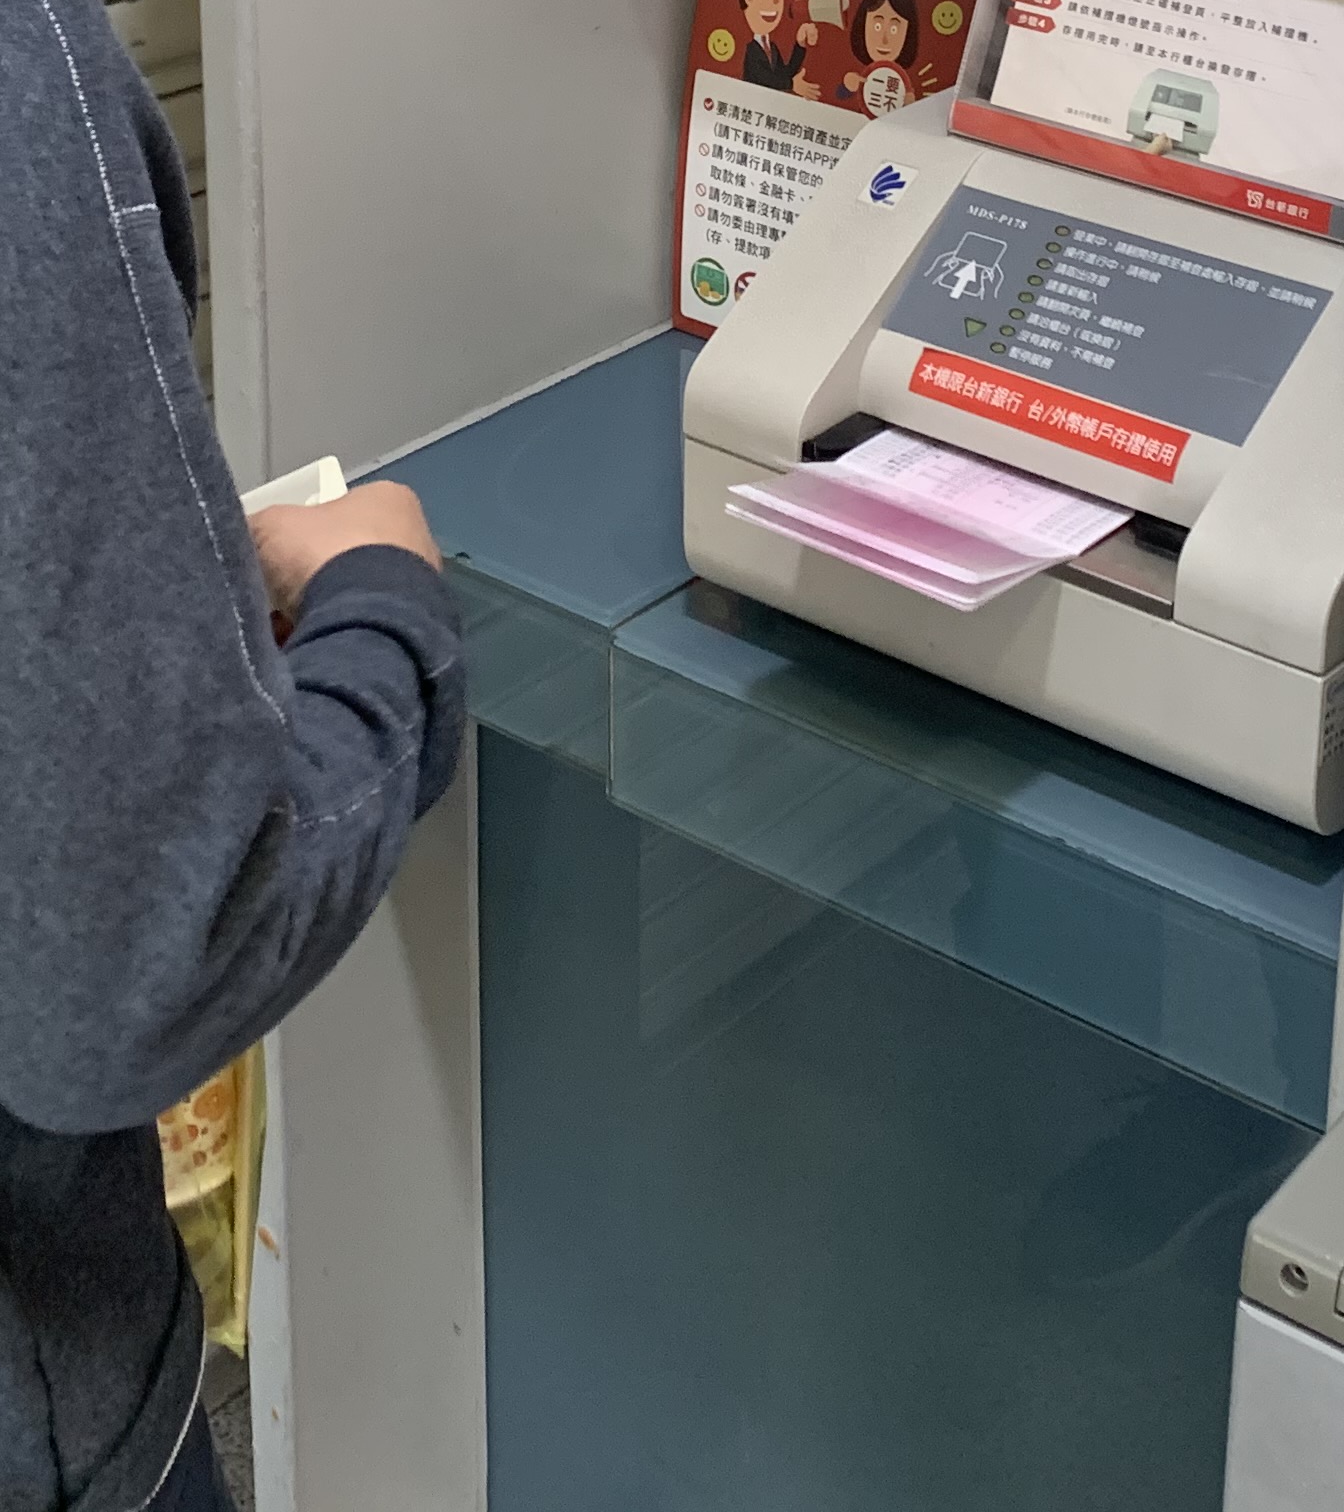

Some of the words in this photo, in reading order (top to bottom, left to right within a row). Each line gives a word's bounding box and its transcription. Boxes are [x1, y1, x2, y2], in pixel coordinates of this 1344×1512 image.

[918, 362, 1024, 414] 本機限台新銀行
